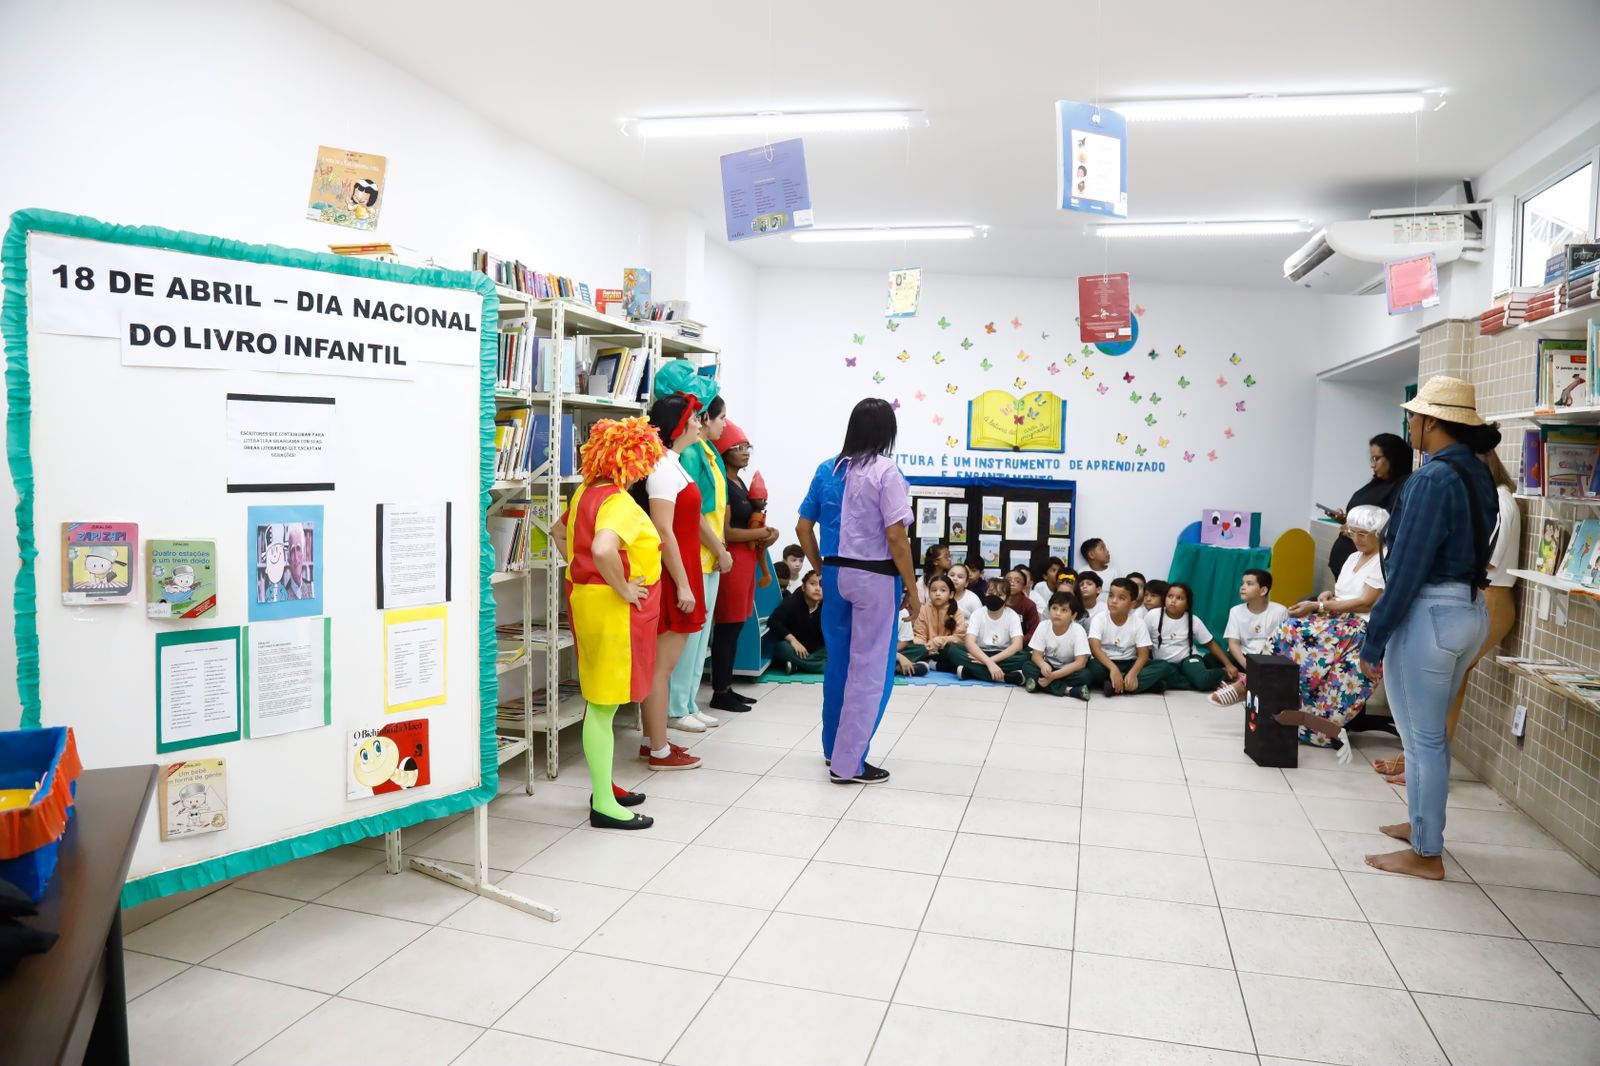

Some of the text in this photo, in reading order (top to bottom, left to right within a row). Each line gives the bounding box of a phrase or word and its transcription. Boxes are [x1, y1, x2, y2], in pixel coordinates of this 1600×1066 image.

[52, 264, 95, 291] 18
[109, 269, 154, 297] DE
[166, 276, 262, 307] ABRIL
[297, 290, 343, 316] DIA
[353, 297, 477, 332] NACIONAL
[129, 323, 407, 366] DO LIVRO INFANTIL
[941, 453, 949, 467] É
[953, 454, 971, 468] UM
[975, 456, 1060, 470] INSTRUMENTO
[1069, 459, 1083, 470] DE
[1086, 459, 1166, 472] APRENDIZADO
[353, 731, 361, 740] O
